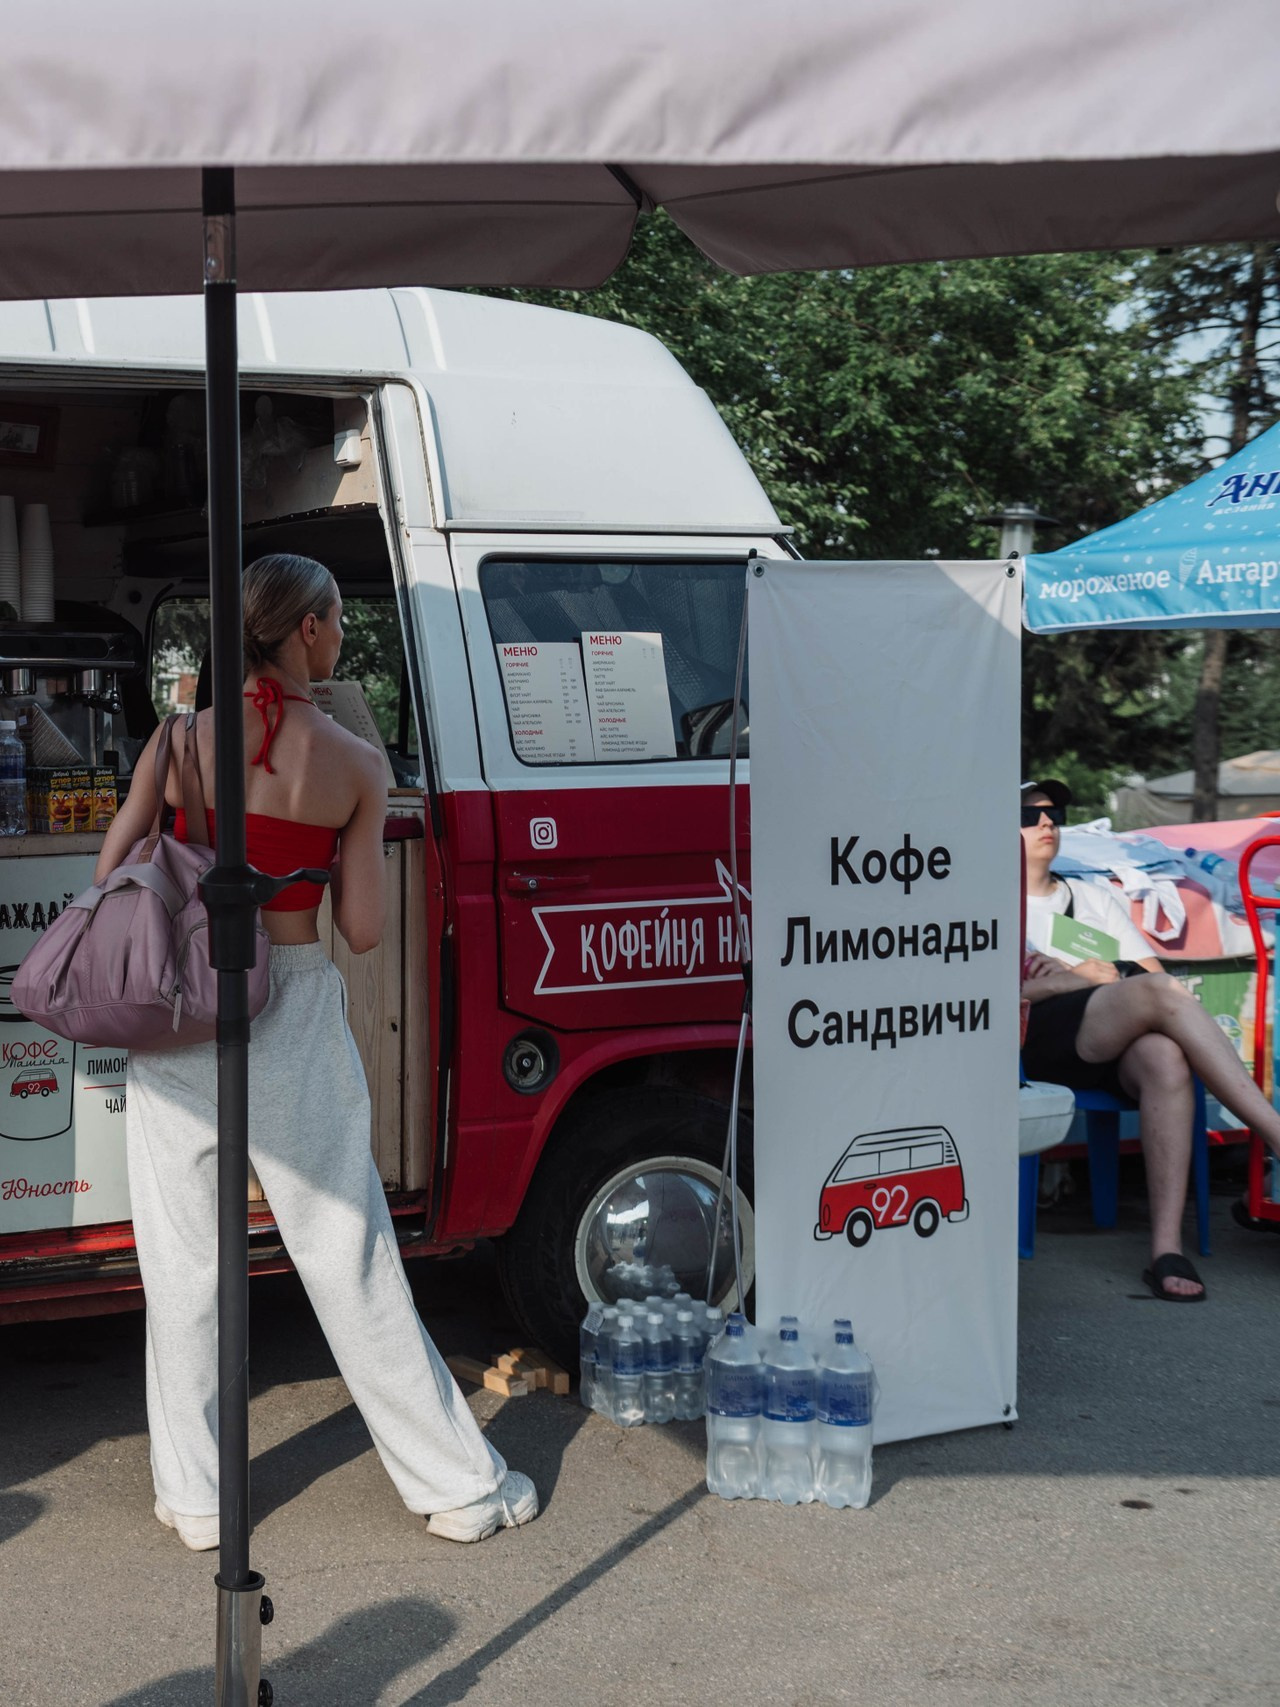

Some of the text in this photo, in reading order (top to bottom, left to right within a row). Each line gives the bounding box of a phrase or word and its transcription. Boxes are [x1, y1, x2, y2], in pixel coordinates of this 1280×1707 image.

[1196, 559, 1280, 587] Ангар
[503, 647, 538, 656] МЕНЮ
[590, 636, 622, 645] МЕНЮ
[831, 833, 951, 895] Кофе
[581, 907, 704, 982] КОФЕЙНЯ
[781, 916, 998, 967] Лимонады
[788, 999, 989, 1051] Сандвичи
[27, 1083, 40, 1093] 92
[1, 1178, 92, 1200] Юность
[872, 1185, 909, 1223] 92
